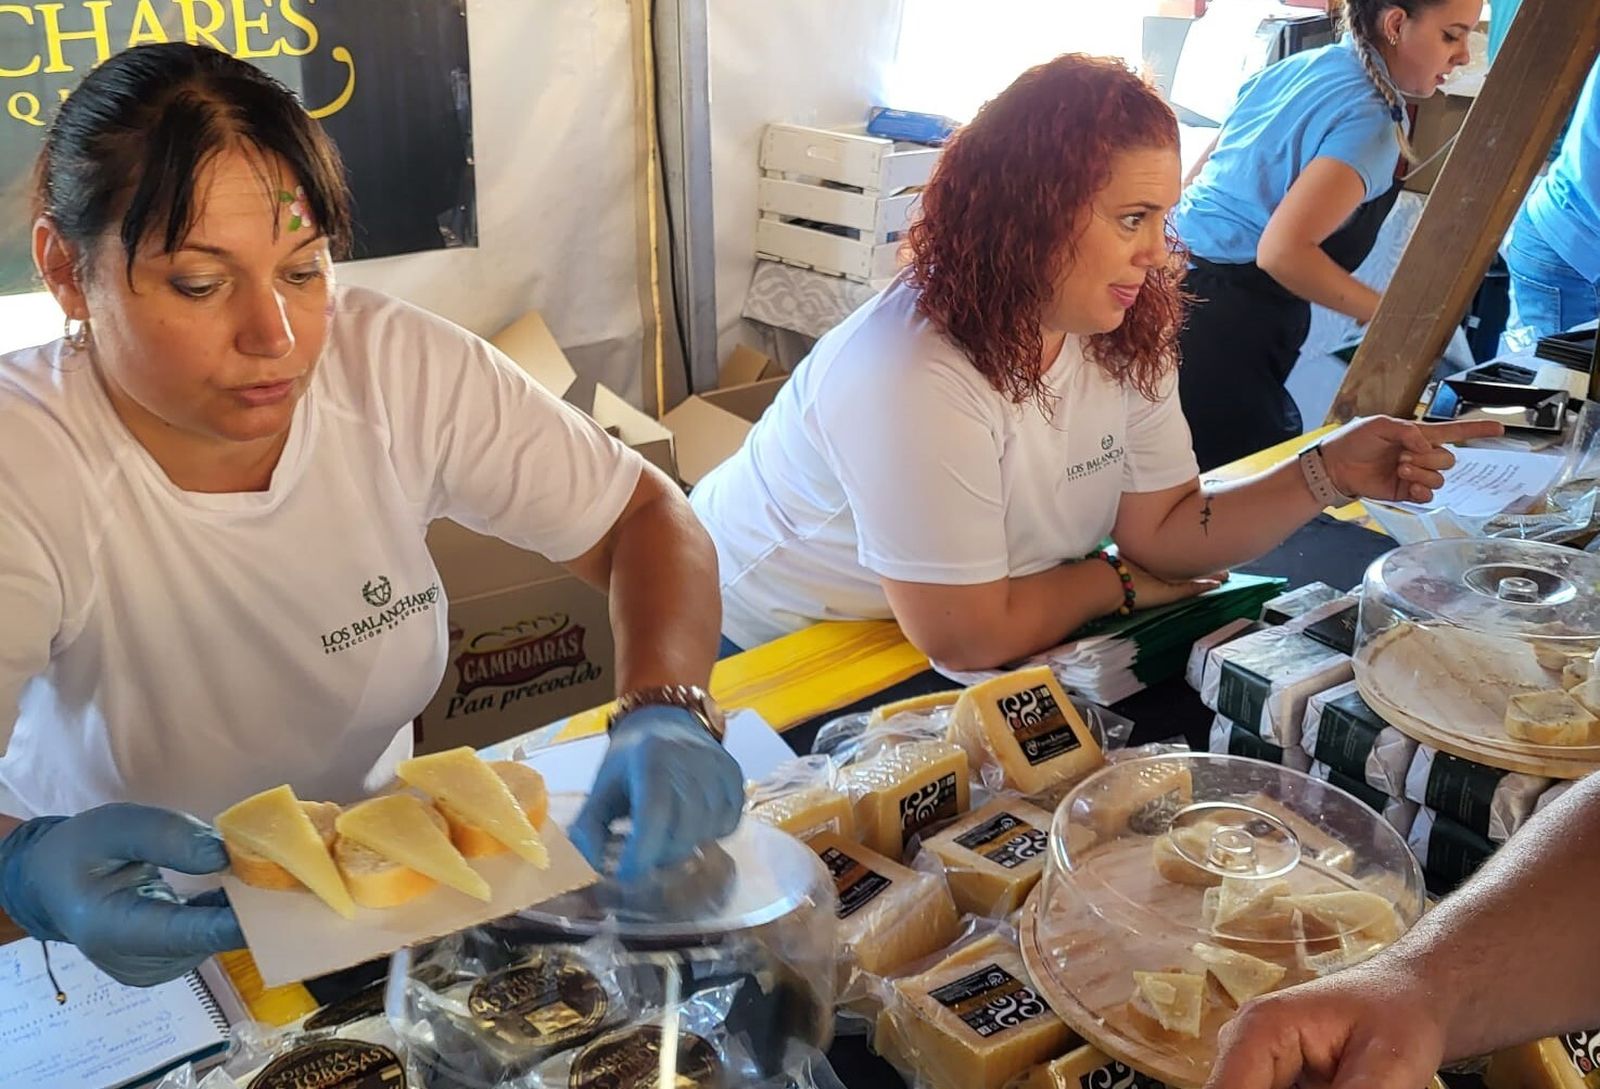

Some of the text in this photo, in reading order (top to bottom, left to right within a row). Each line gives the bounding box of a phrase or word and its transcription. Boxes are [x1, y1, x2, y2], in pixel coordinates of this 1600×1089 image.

[321, 627, 351, 648] LOS
[463, 632, 579, 683] CAMPOARAS
[446, 661, 602, 719] Pan precocido
